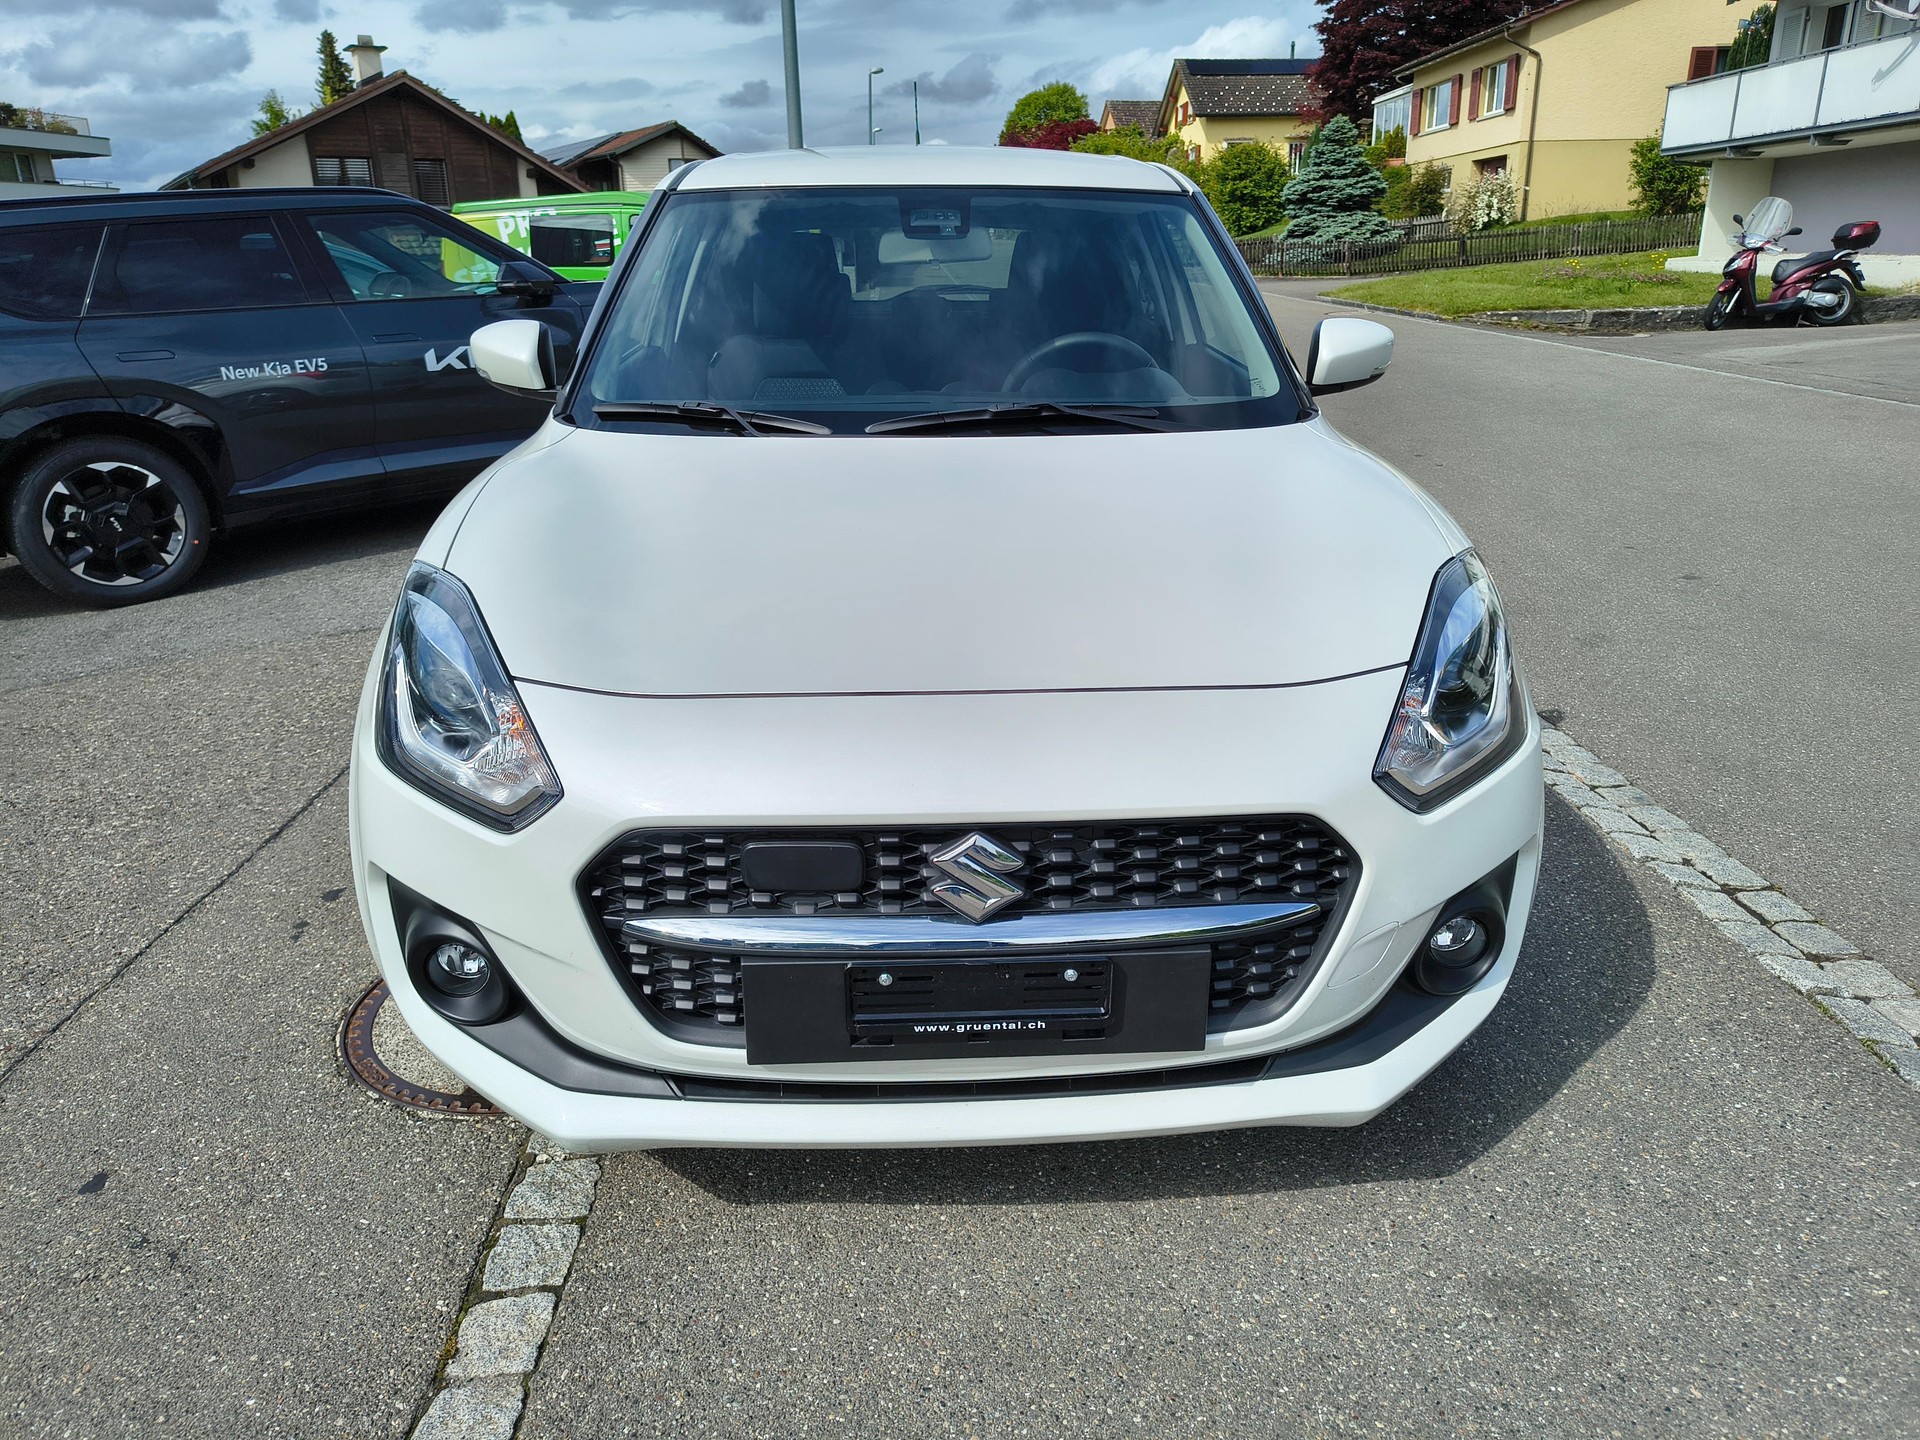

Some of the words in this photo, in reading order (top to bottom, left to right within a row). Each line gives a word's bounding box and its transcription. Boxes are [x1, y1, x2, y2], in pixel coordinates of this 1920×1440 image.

[220, 366, 260, 380] New
[263, 361, 292, 377] Kia
[294, 357, 328, 373] EV5
[914, 1020, 1046, 1033] www.gruental.ch
